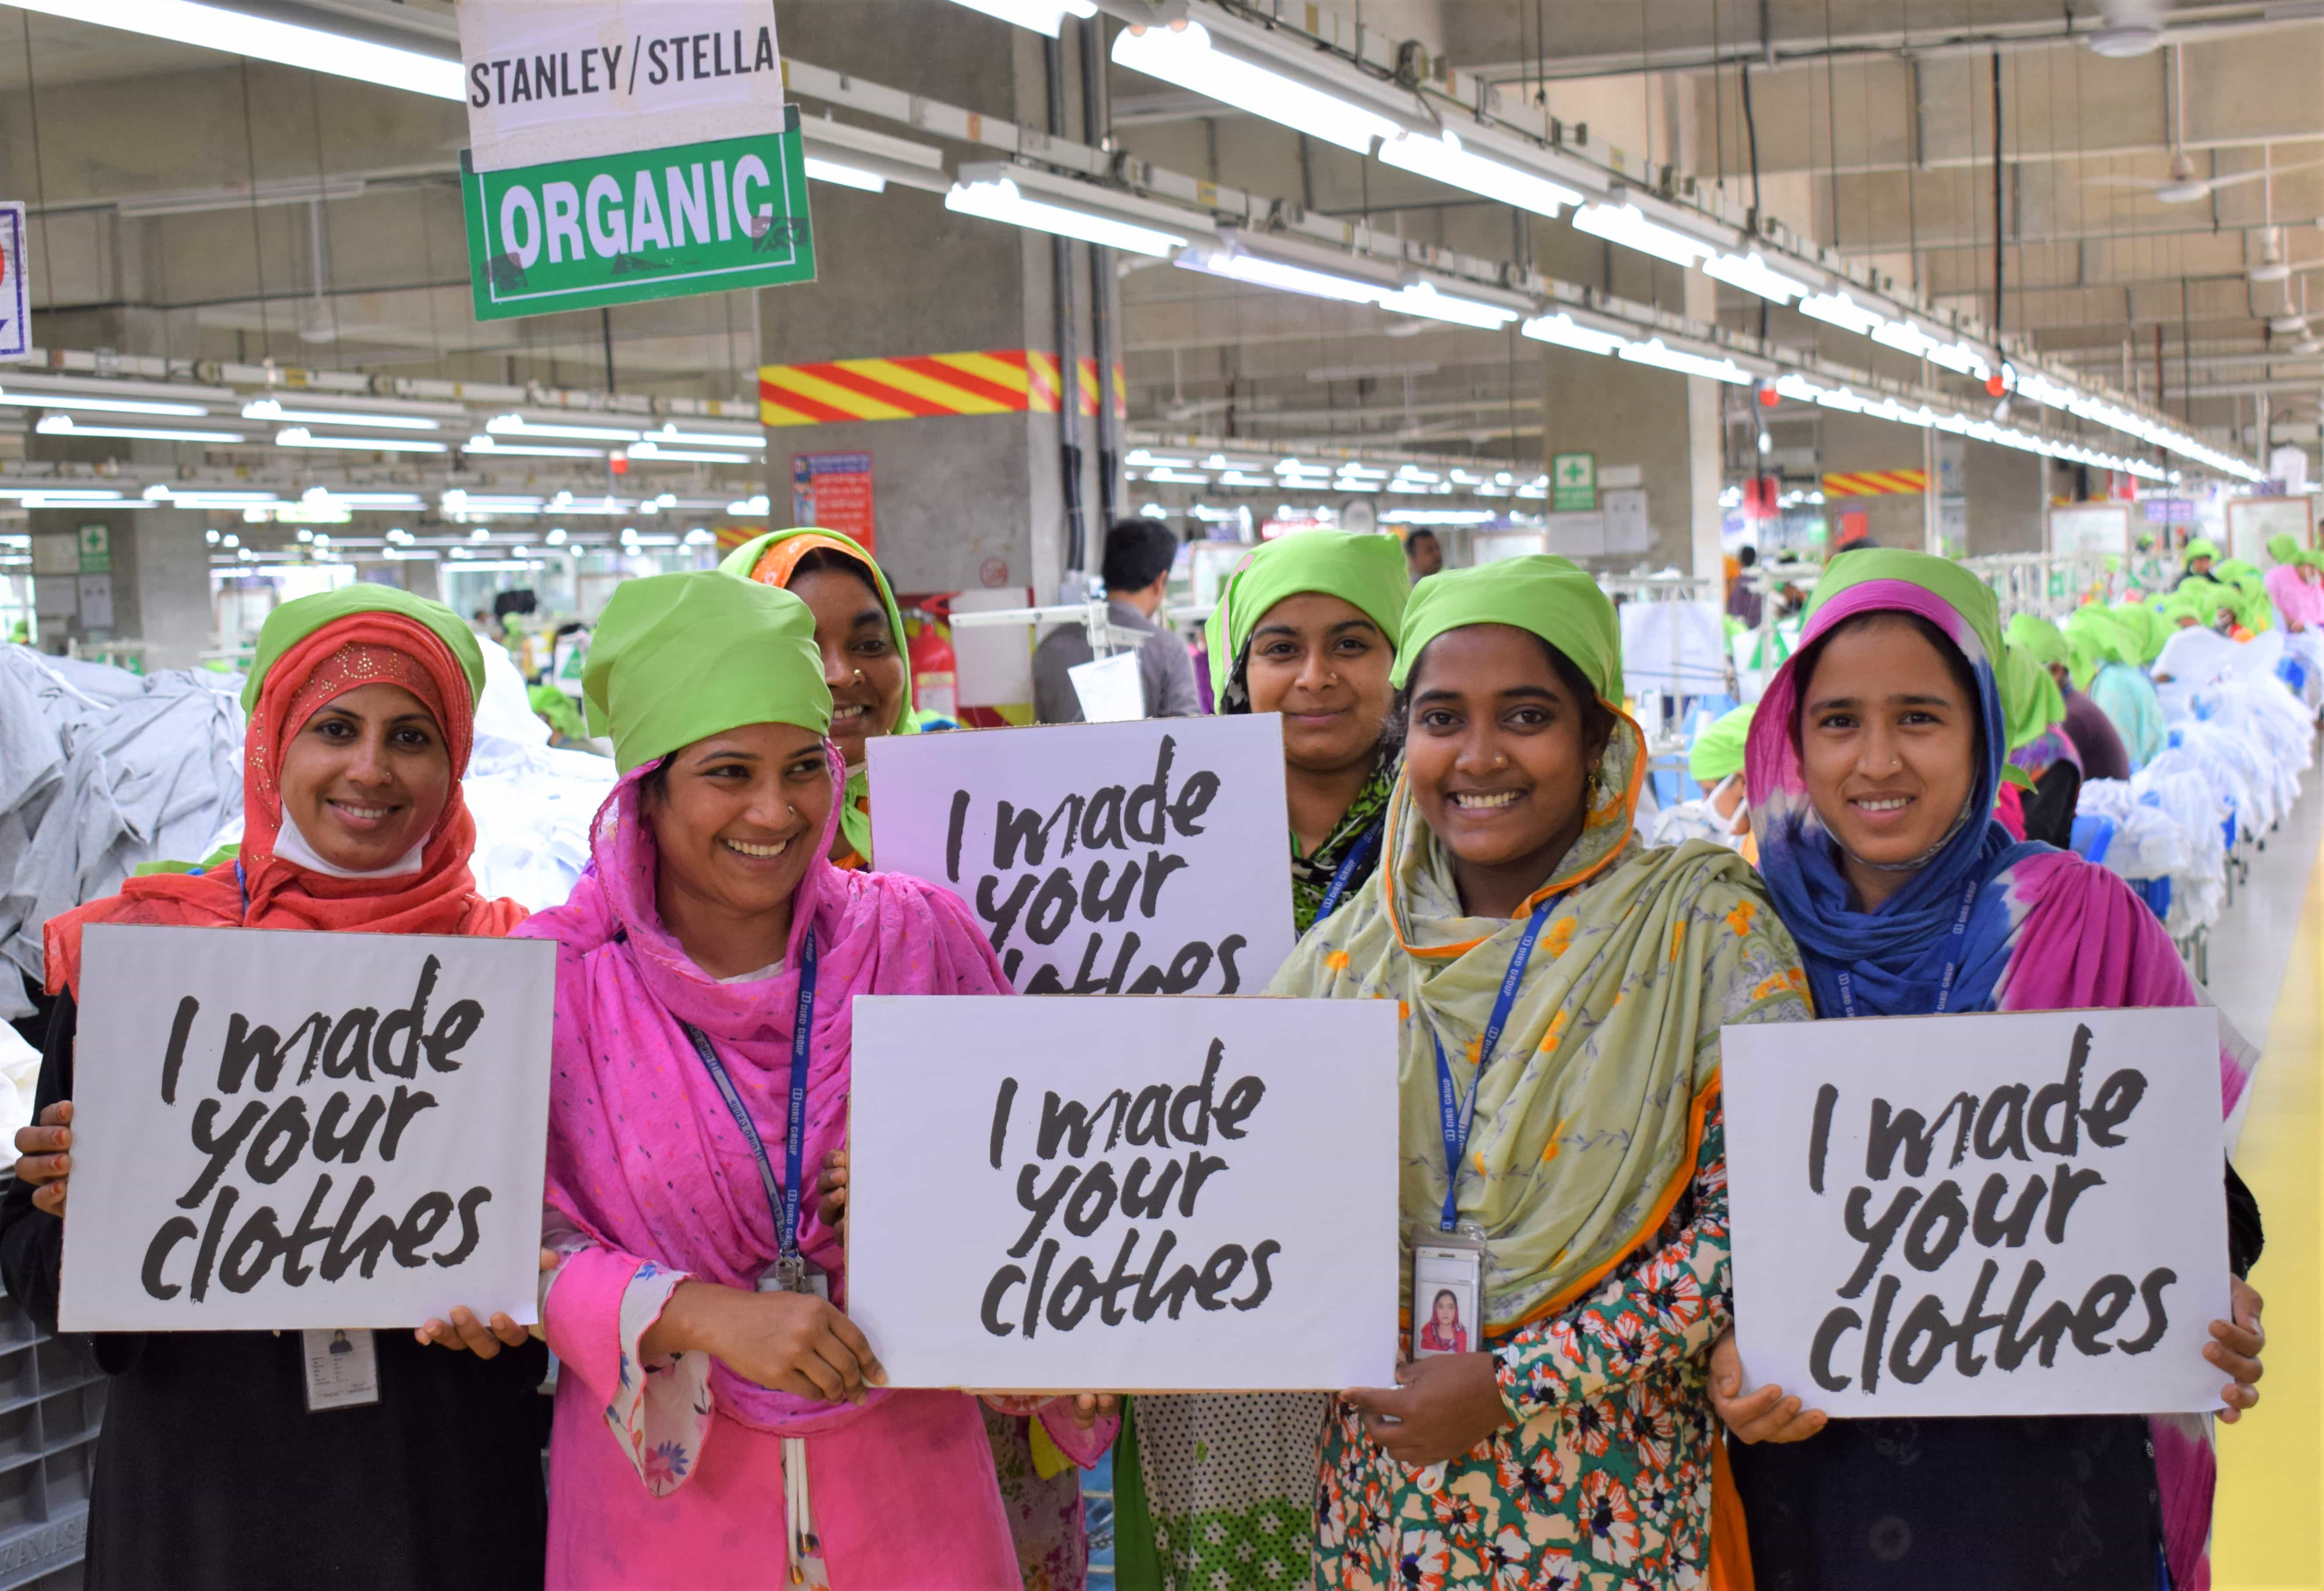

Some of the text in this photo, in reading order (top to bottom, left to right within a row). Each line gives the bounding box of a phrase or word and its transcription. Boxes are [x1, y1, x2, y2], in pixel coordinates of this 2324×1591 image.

[500, 154, 773, 270] ORGANIC
[946, 734, 1221, 884] I made
[976, 850, 1189, 953] your
[161, 953, 485, 1106] I made
[795, 1027, 806, 1056] GROUP
[1503, 969, 1518, 997] GROUP
[175, 1084, 439, 1209] your
[790, 1126, 799, 1156] GROUP
[989, 1037, 1266, 1171] I made
[1442, 1078, 1452, 1105] GROUP
[1809, 1023, 2148, 1195] I made
[140, 1173, 493, 1304] clothes
[1006, 1151, 1230, 1259] your
[1836, 1163, 2107, 1299] your
[980, 1227, 1282, 1340] clothes
[1809, 1258, 2178, 1395] clothes
